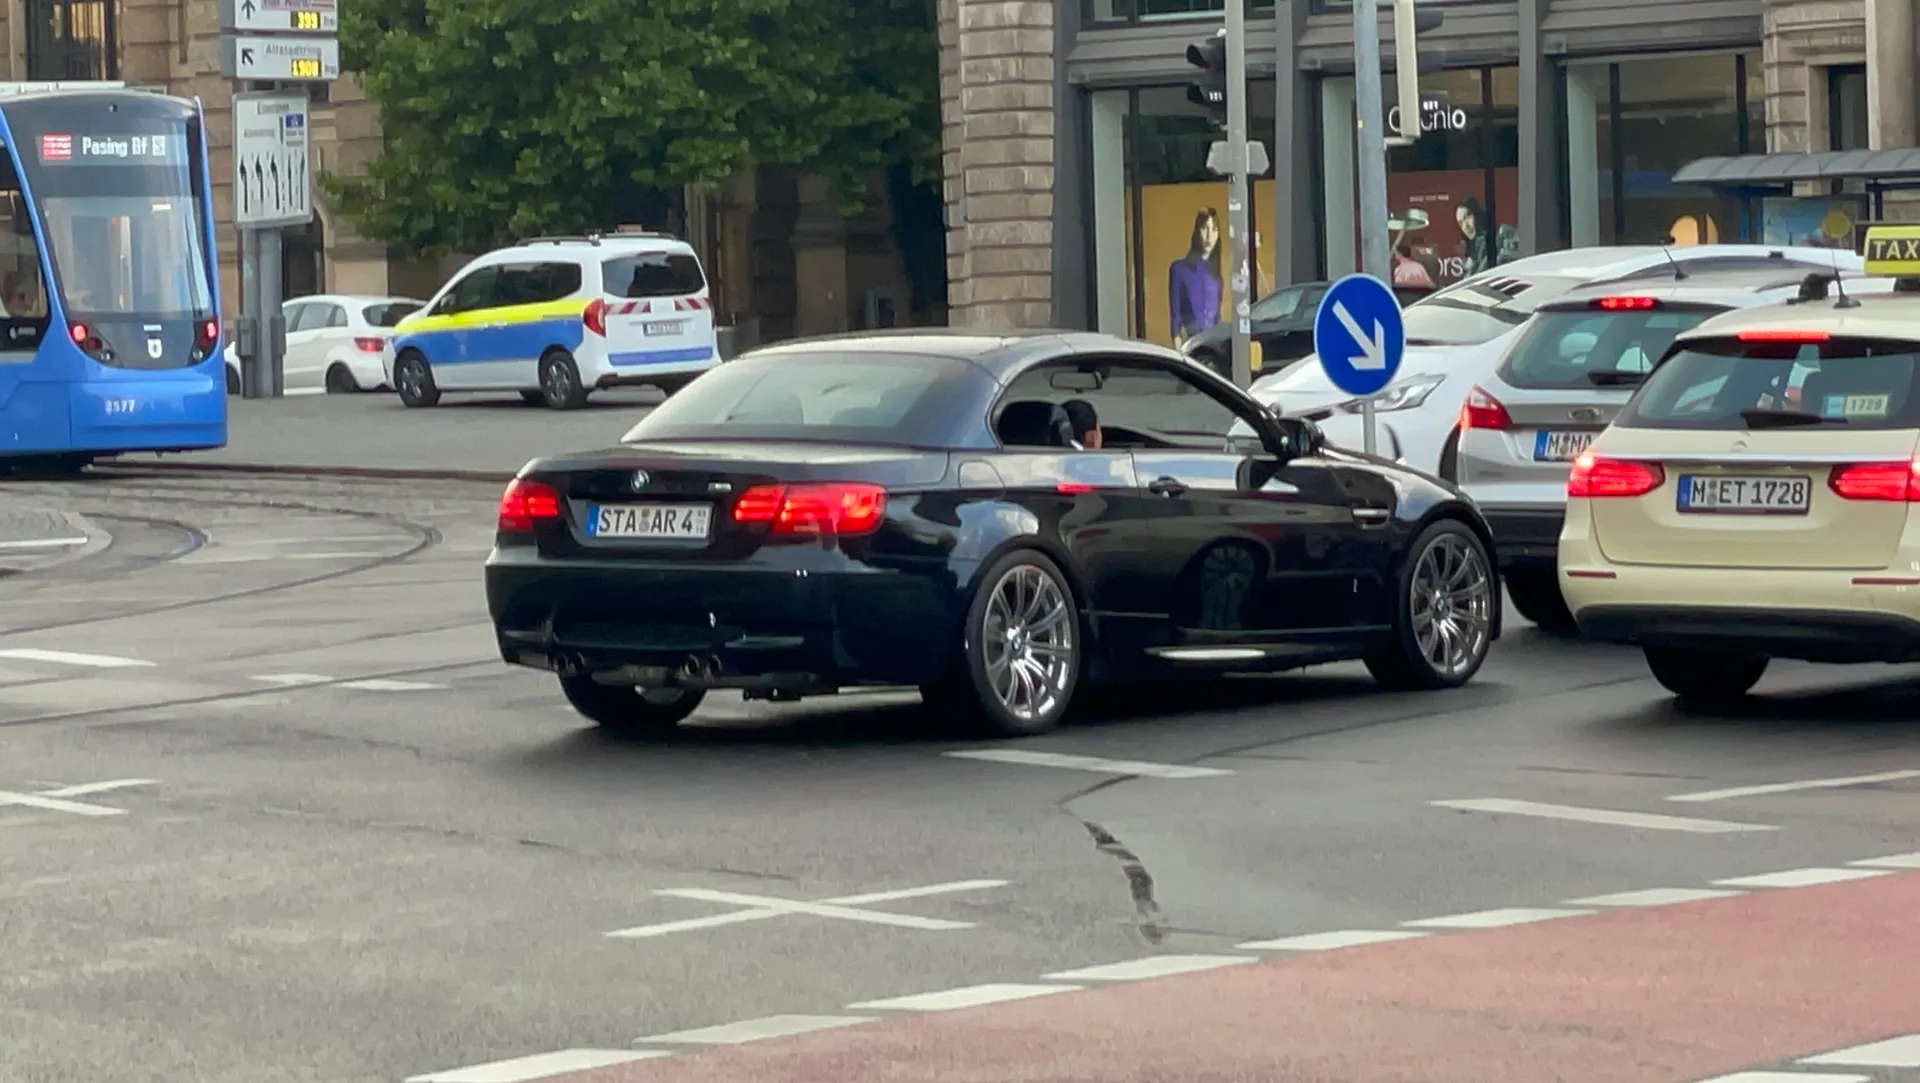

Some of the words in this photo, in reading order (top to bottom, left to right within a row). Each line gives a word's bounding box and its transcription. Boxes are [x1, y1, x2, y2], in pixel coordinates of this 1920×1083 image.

[82, 136, 128, 158] Pasing
[131, 136, 148, 155] Bf
[1547, 433, 1560, 454] M
[1691, 480, 1706, 503] M
[1719, 480, 1747, 504] ET
[1750, 481, 1804, 505] 1728
[598, 508, 636, 533] STA
[650, 509, 677, 533] AR
[681, 509, 693, 533] 4
